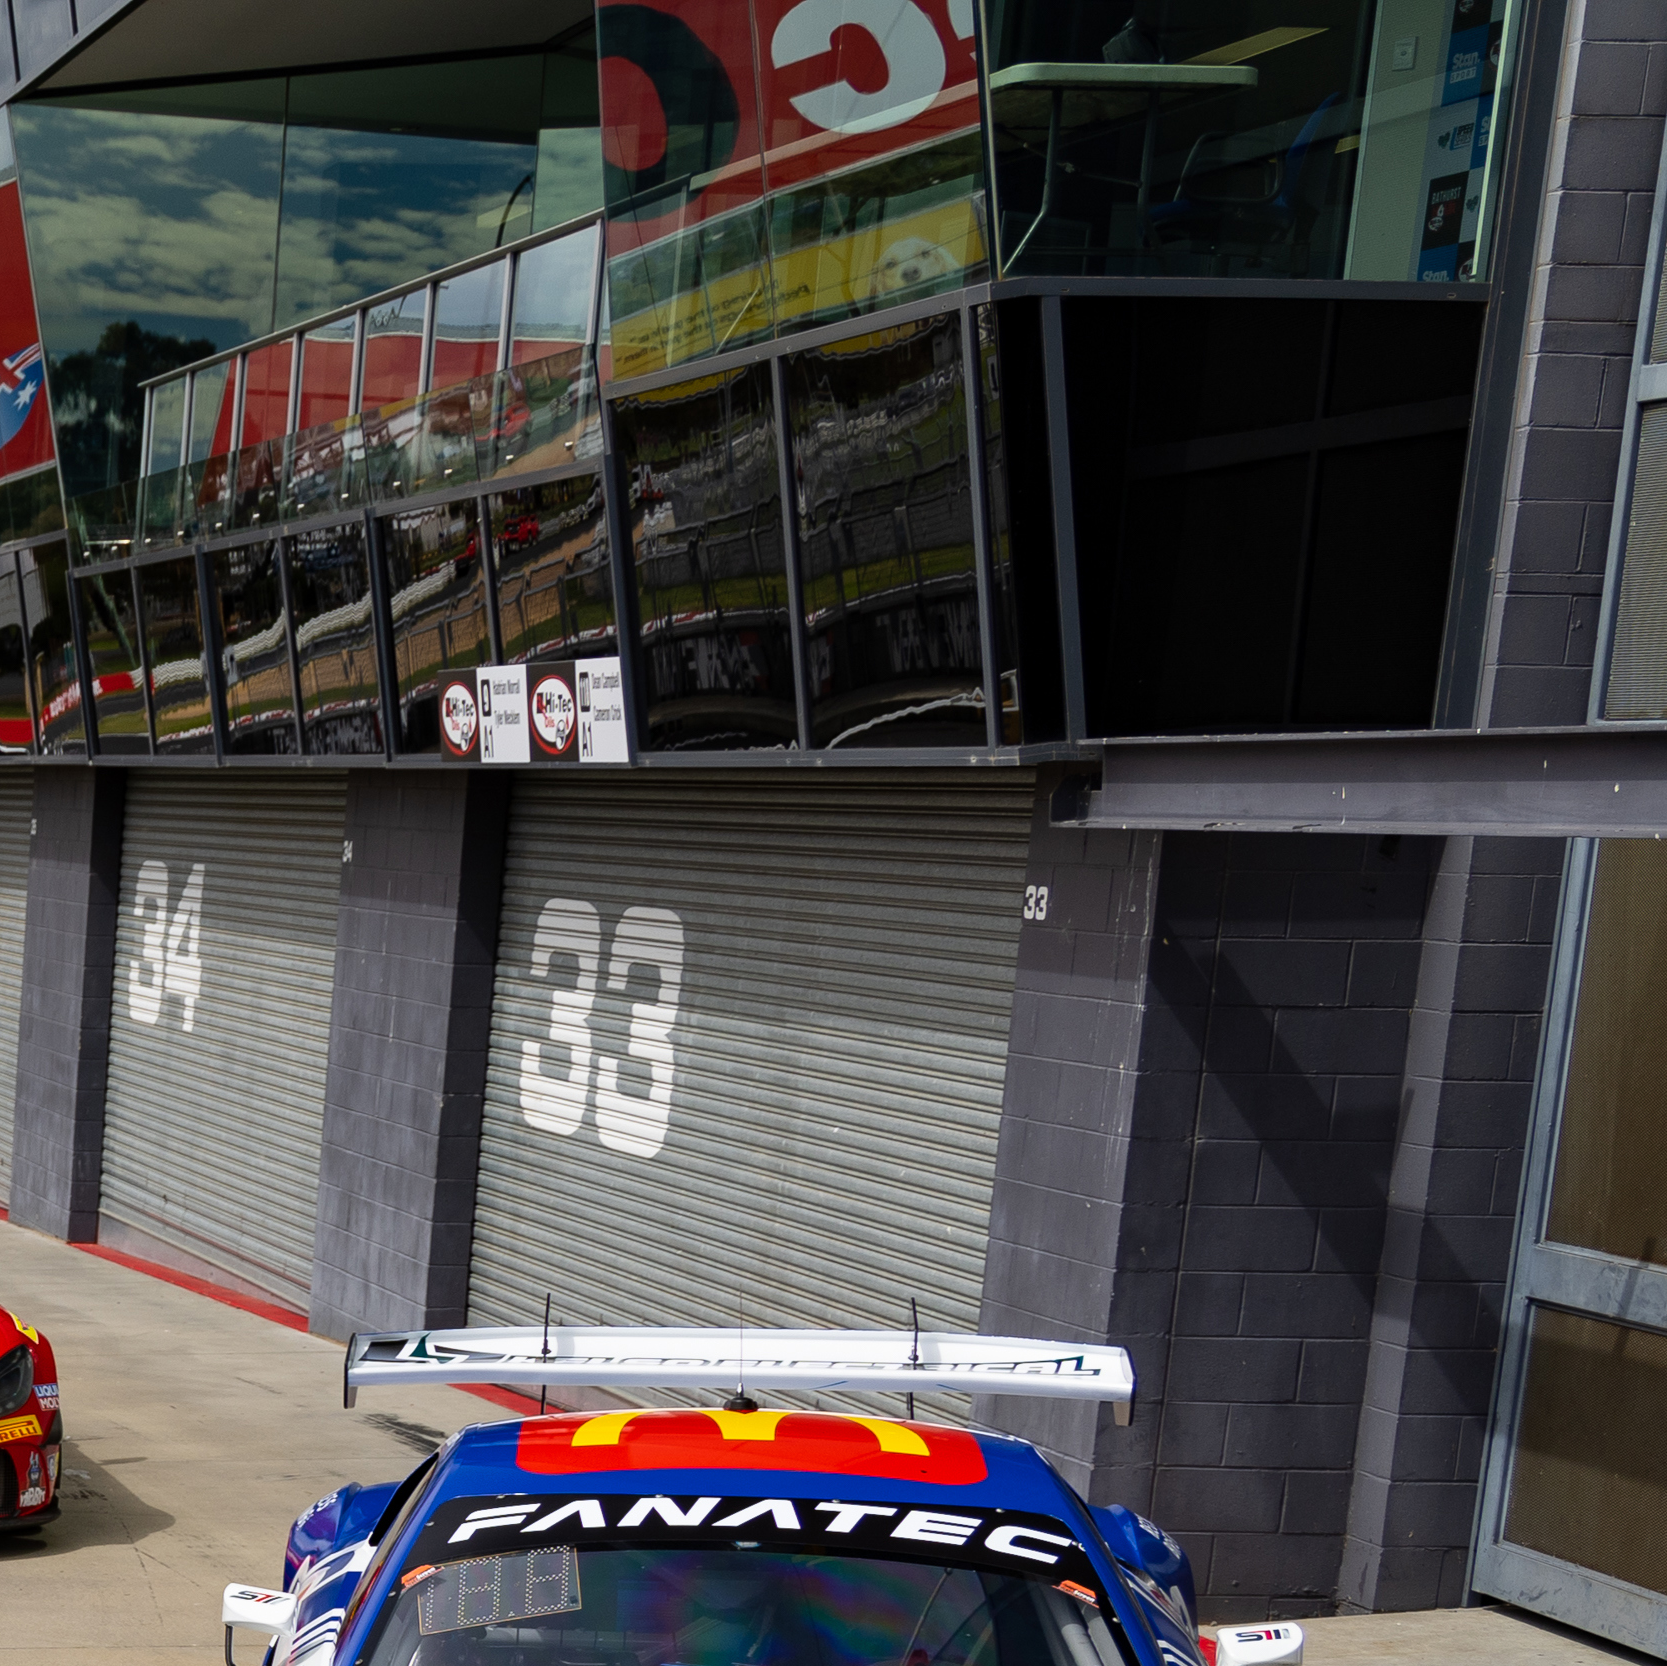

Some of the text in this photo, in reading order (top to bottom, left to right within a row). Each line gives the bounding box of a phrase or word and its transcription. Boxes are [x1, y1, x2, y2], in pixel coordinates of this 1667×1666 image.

[545, 691, 572, 714] Hi-Tec
[1023, 885, 1049, 921] 33
[128, 860, 206, 1033] 34
[519, 897, 685, 1159] 33
[448, 1497, 1073, 1565] FANATEC
